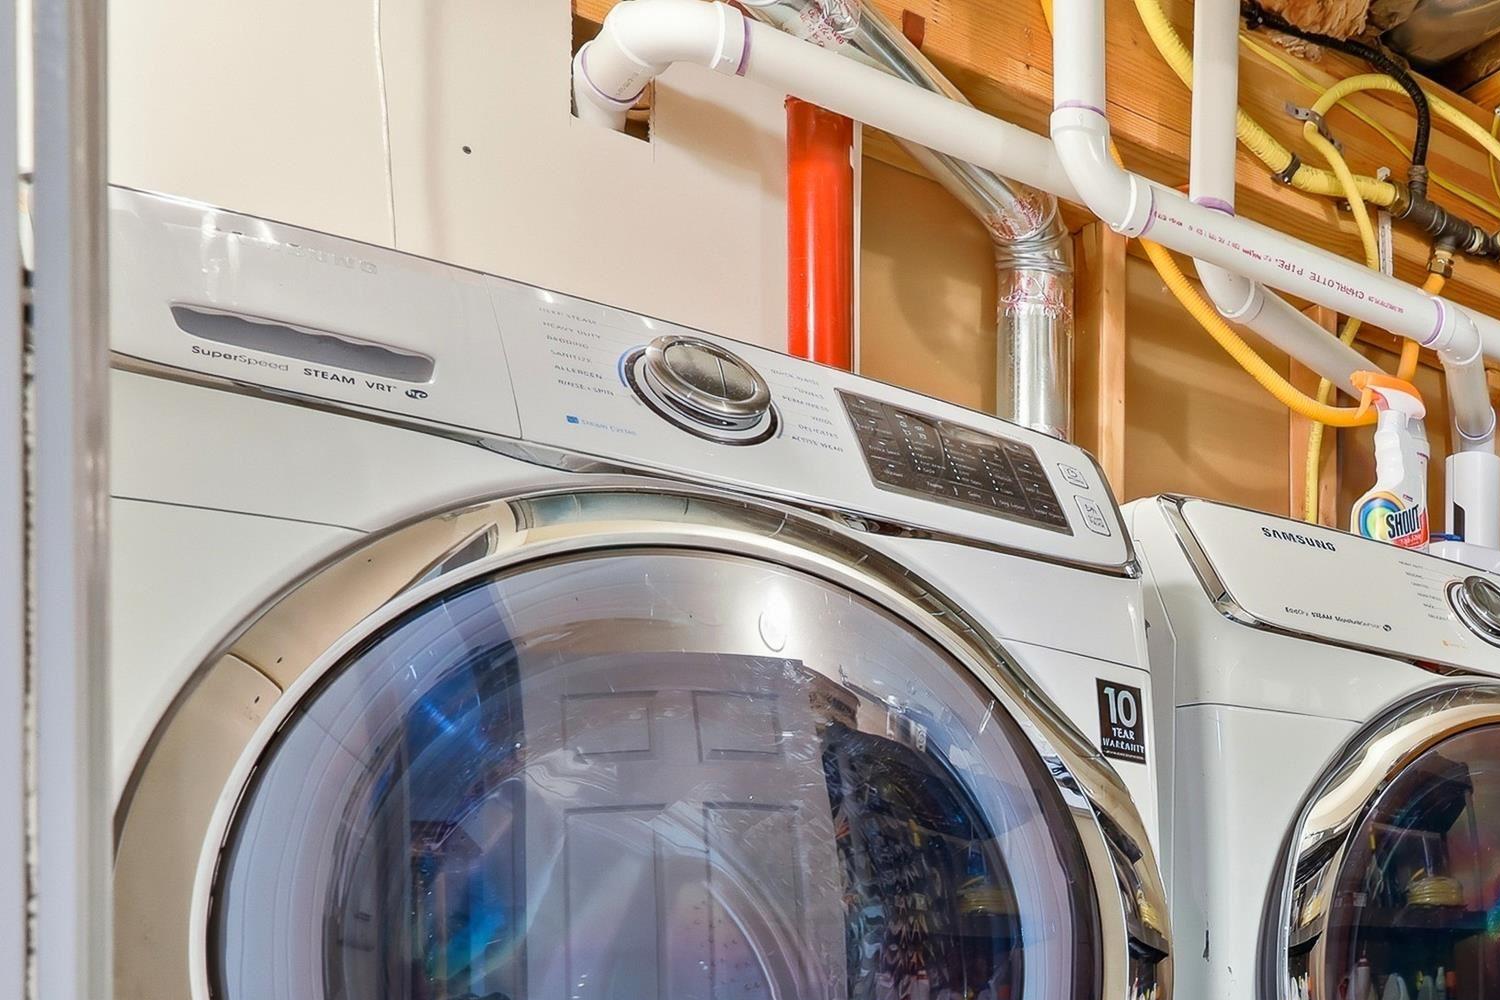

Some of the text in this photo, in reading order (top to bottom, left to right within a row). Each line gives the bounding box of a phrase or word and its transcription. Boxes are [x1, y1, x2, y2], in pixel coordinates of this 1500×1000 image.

[1309, 271, 1365, 299] CHARLOTTE
[191, 345, 289, 372] SuperSpeed
[303, 367, 355, 385] STEAM
[1386, 504, 1419, 539] SHOUT
[1261, 527, 1336, 552] SAMSUNG
[1104, 687, 1137, 728] 10
[1103, 737, 1145, 754] WARRANTY
[1112, 727, 1135, 741] YEAR
